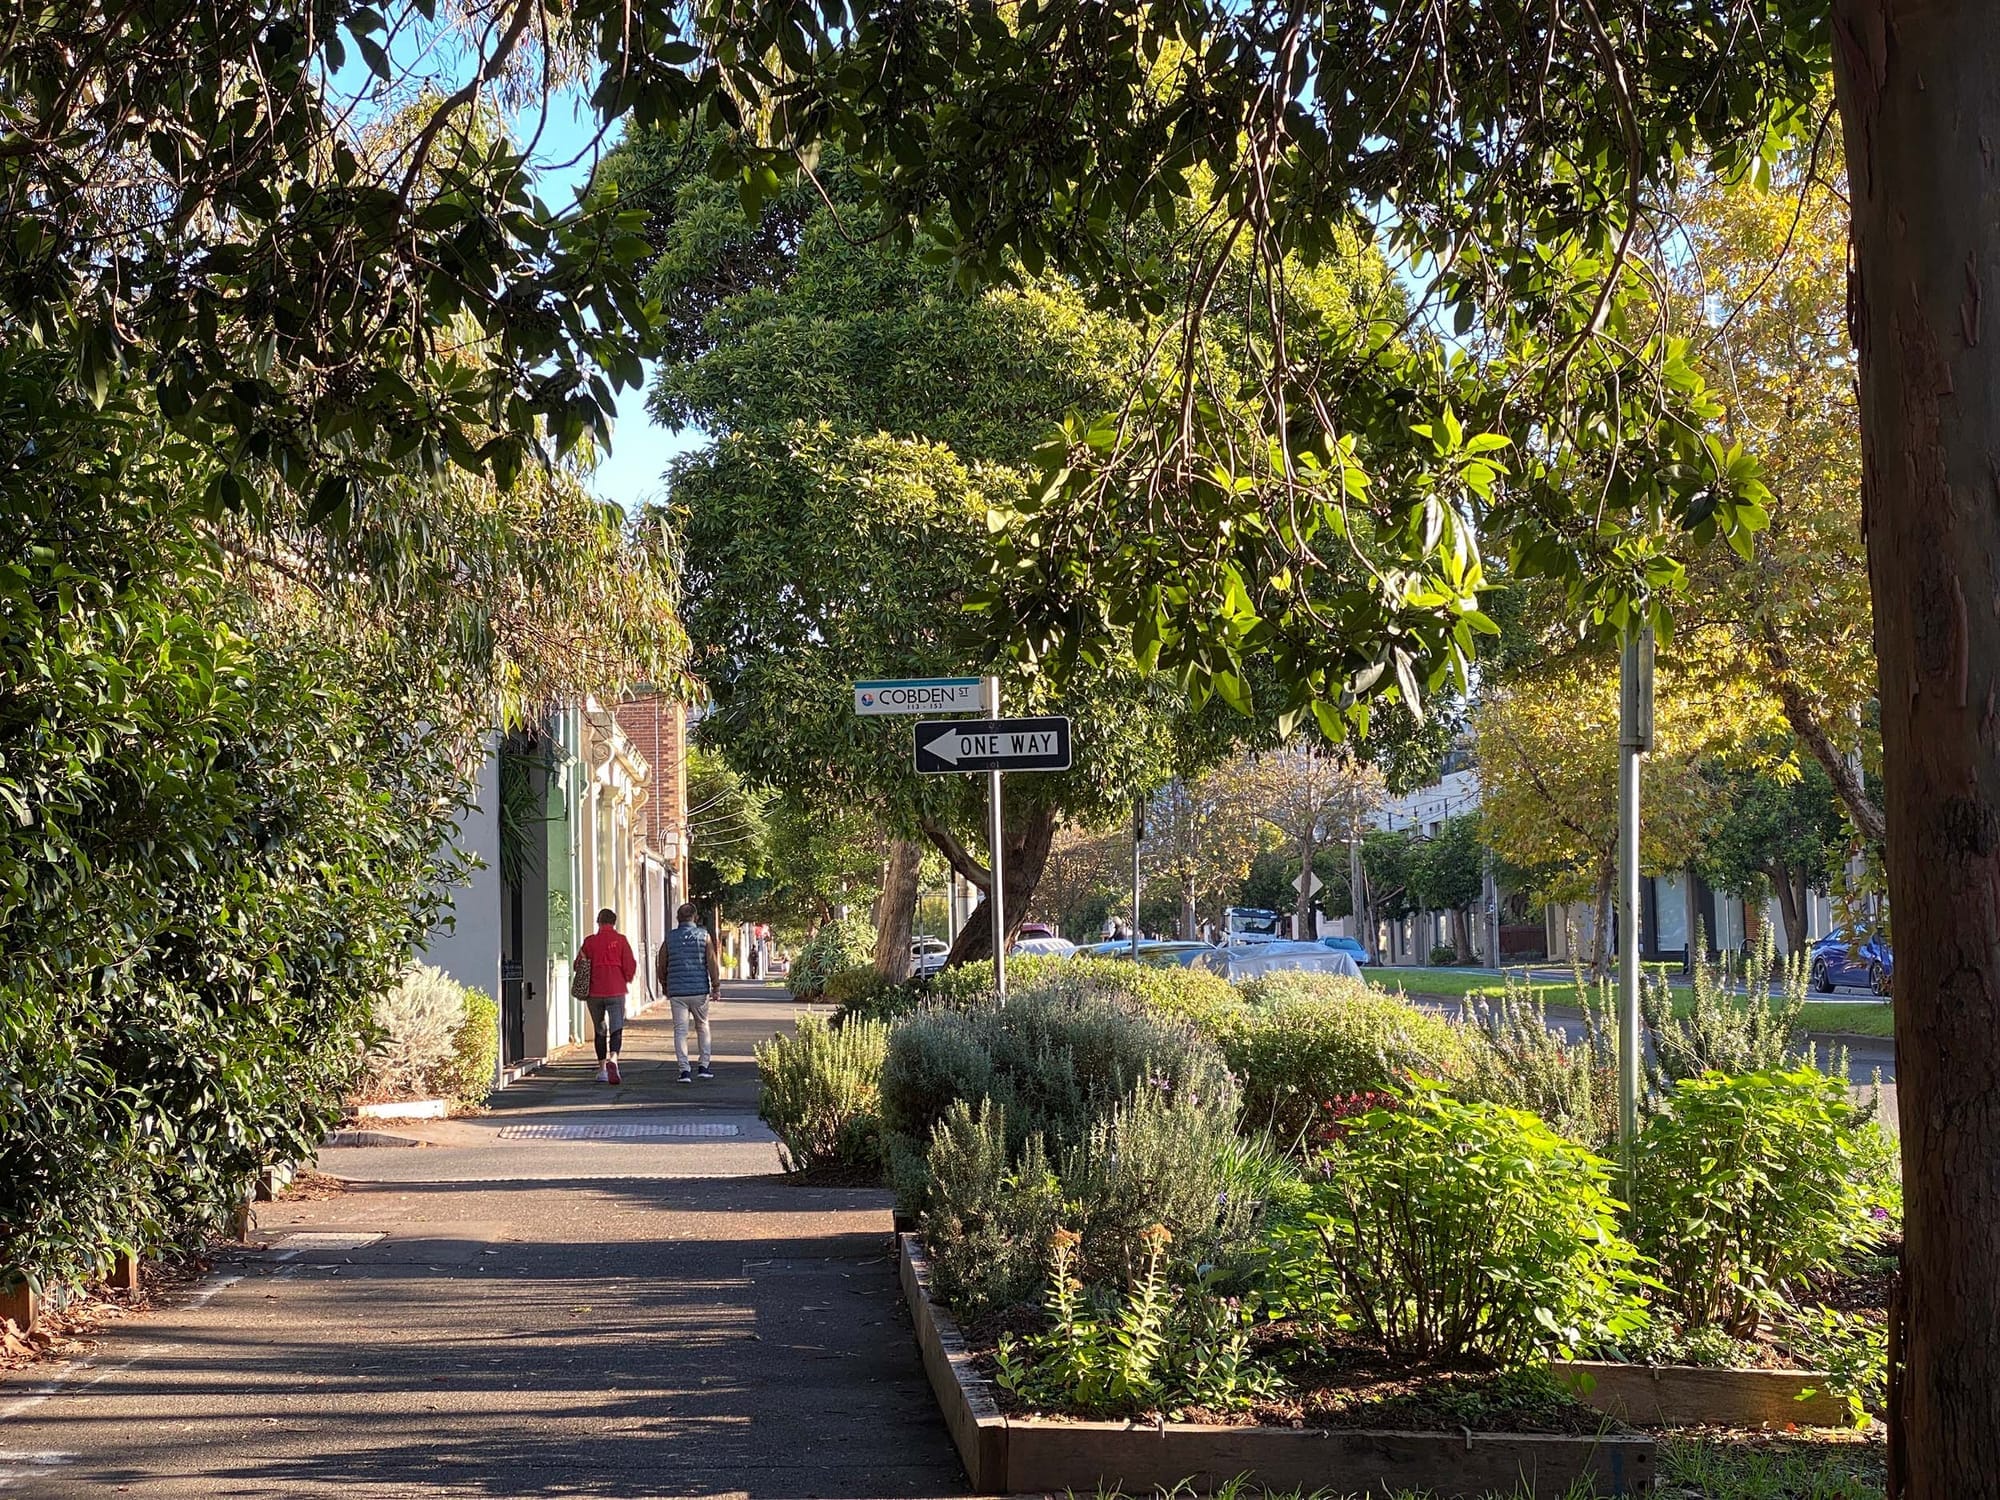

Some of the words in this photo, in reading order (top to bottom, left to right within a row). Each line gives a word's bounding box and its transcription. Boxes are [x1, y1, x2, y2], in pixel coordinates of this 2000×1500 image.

[879, 688, 955, 705] COBDEN
[958, 687, 969, 697] ST
[960, 735, 999, 755] ONE
[1011, 734, 1052, 754] WAY
